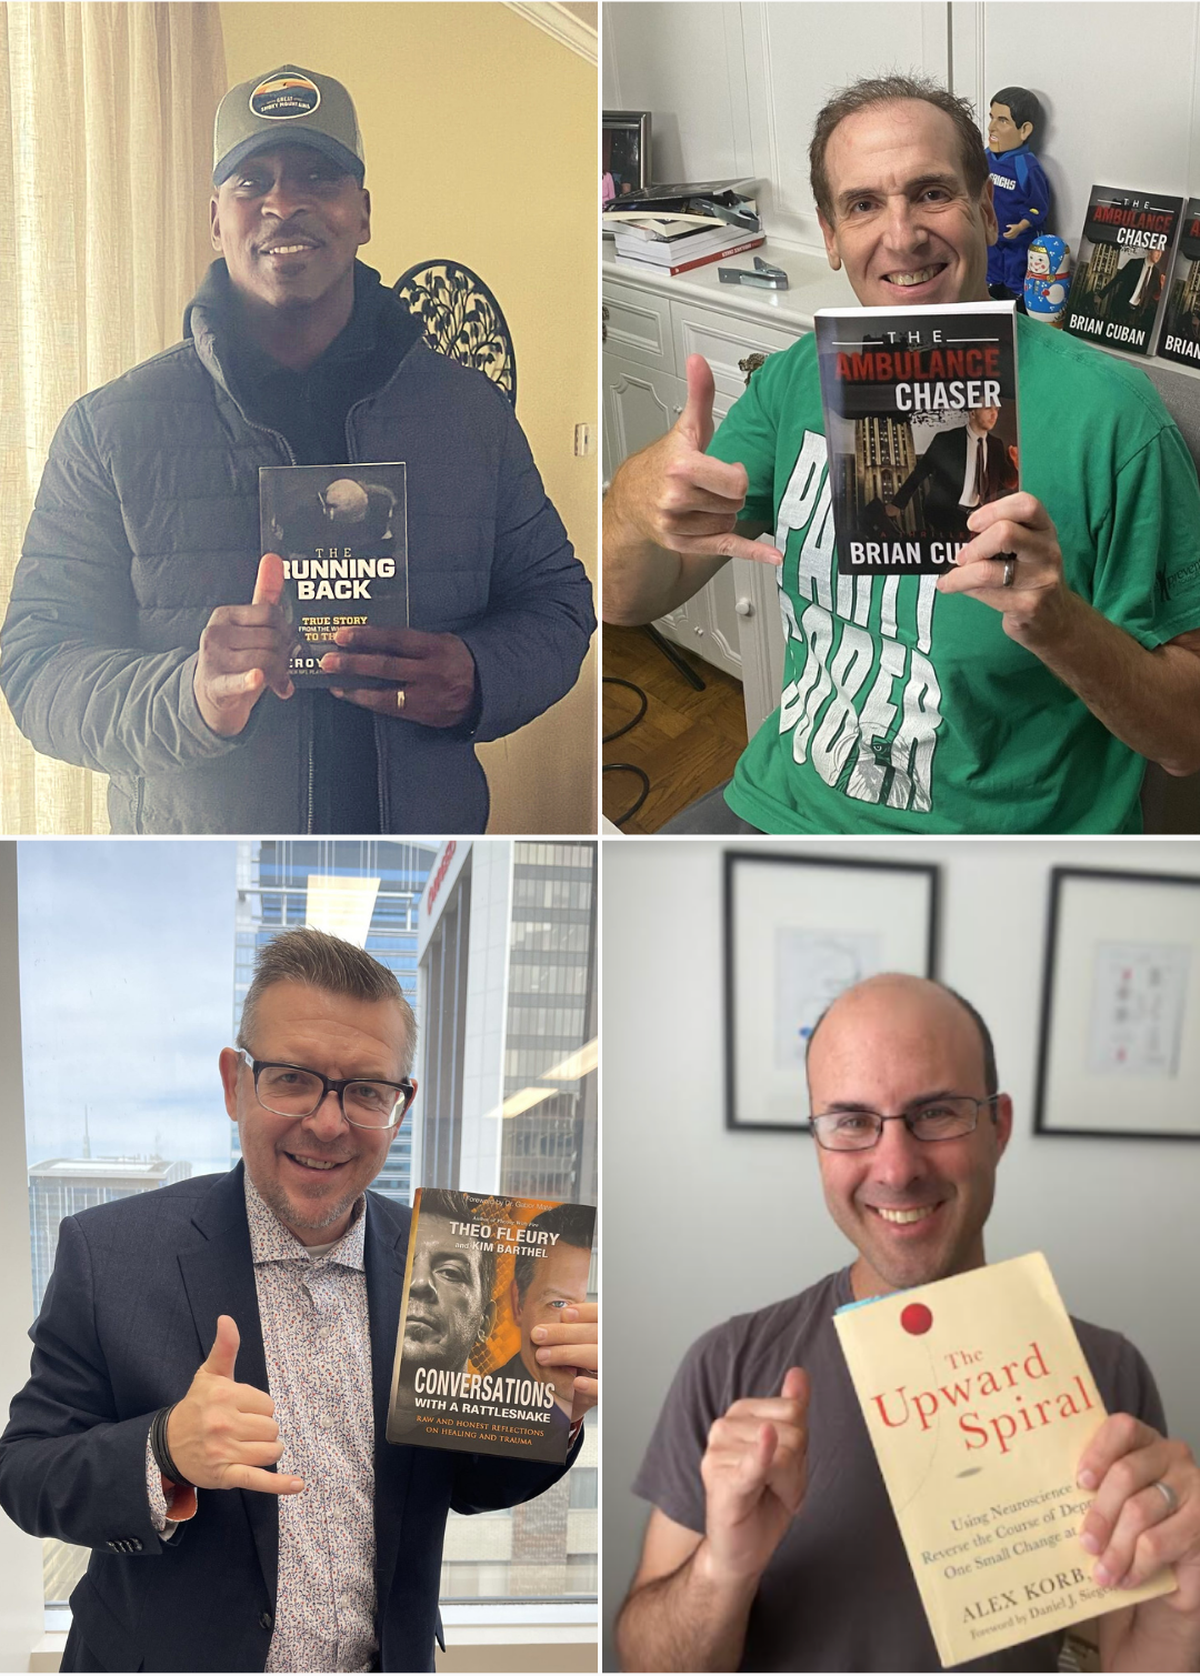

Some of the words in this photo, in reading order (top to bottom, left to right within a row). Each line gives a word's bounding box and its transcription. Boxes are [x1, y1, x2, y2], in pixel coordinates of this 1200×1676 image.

[1123, 198, 1150, 209] THE
[1094, 206, 1172, 234] AMBULANCE
[1116, 227, 1167, 251] CHASER
[887, 330, 942, 344] THE
[1069, 313, 1104, 335] BRIAN
[1106, 322, 1146, 346] CUBAN
[835, 348, 1001, 381] AMBULANCE
[895, 380, 1002, 412] CHASER
[316, 548, 352, 558] THE
[850, 541, 922, 565] BRIAN
[297, 579, 371, 600] BACK
[302, 617, 330, 625] TRUE
[333, 616, 367, 625] STORY
[304, 633, 319, 641] TO
[320, 633, 336, 641] TH
[450, 1221, 491, 1239] THEO
[496, 1227, 560, 1246] FLEURY
[471, 1241, 493, 1252] KIM
[497, 1244, 549, 1258] BARTHEL
[944, 1349, 984, 1370] The
[414, 1367, 555, 1409] CONVERSATIONS
[871, 1342, 1052, 1432] Upward
[415, 1397, 446, 1411] WITH
[449, 1402, 459, 1412] A
[462, 1403, 551, 1423] RATTLESNAKE
[958, 1375, 1095, 1455] Spiral
[416, 1415, 434, 1423] RAW
[436, 1418, 454, 1426] AND
[456, 1420, 489, 1430] HONEST
[491, 1423, 545, 1437] REFLECTIONS
[425, 1426, 439, 1434] ON
[441, 1428, 477, 1439] HEALING
[478, 1433, 498, 1441] AND
[499, 1435, 533, 1446] TRAUMA
[951, 1511, 990, 1532] Using
[989, 1483, 1073, 1520] Neuroscience
[920, 1541, 970, 1565] Reverse
[972, 1533, 993, 1548] the
[995, 1517, 1040, 1540] Course
[1043, 1507, 1057, 1523] of
[1059, 1498, 1093, 1521] Depr
[943, 1561, 973, 1580] One
[974, 1547, 1011, 1570] Small
[1011, 1531, 1062, 1556] Change
[1064, 1526, 1079, 1539] at
[962, 1589, 1019, 1624] ALEX
[1023, 1567, 1093, 1601] KORB,
[969, 1617, 1015, 1641] Foreword
[1015, 1613, 1028, 1626] by
[1028, 1597, 1067, 1620] Daniel
